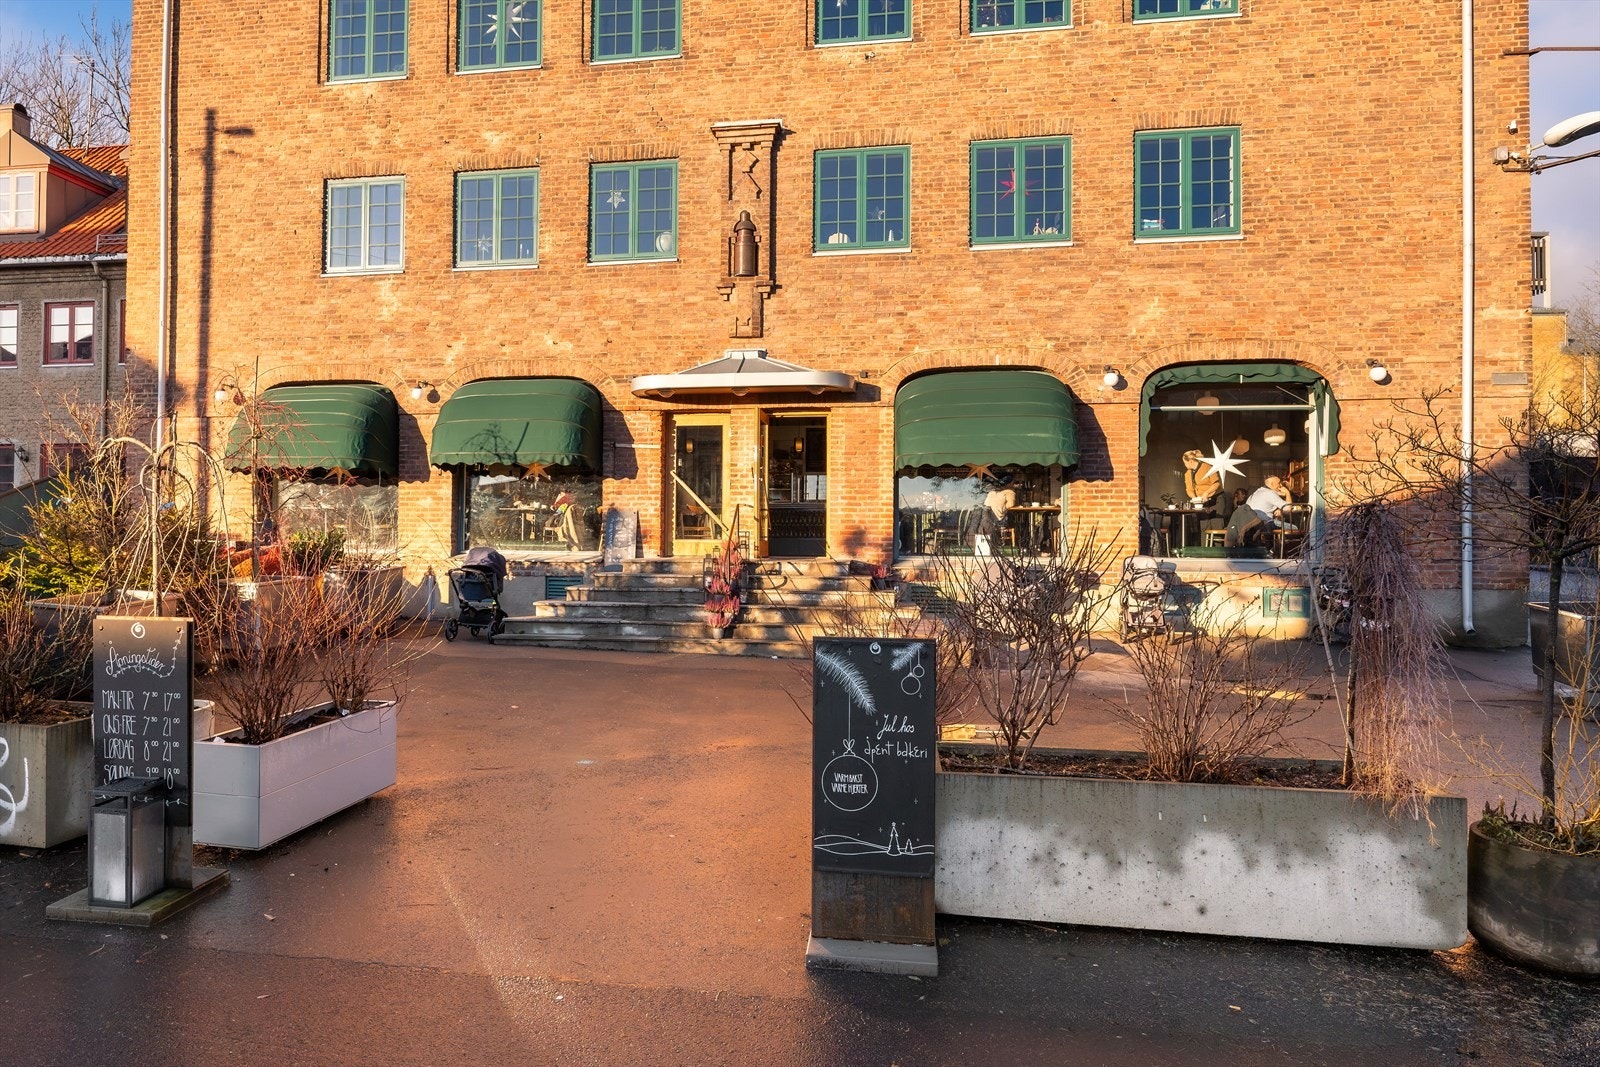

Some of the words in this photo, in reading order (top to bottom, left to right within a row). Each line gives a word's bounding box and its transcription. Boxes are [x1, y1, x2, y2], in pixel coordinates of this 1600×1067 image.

[103, 714, 137, 736] ONS-FRE
[877, 714, 897, 740] Jul
[897, 716, 915, 733] hos
[103, 738, 135, 763] LØRDAG
